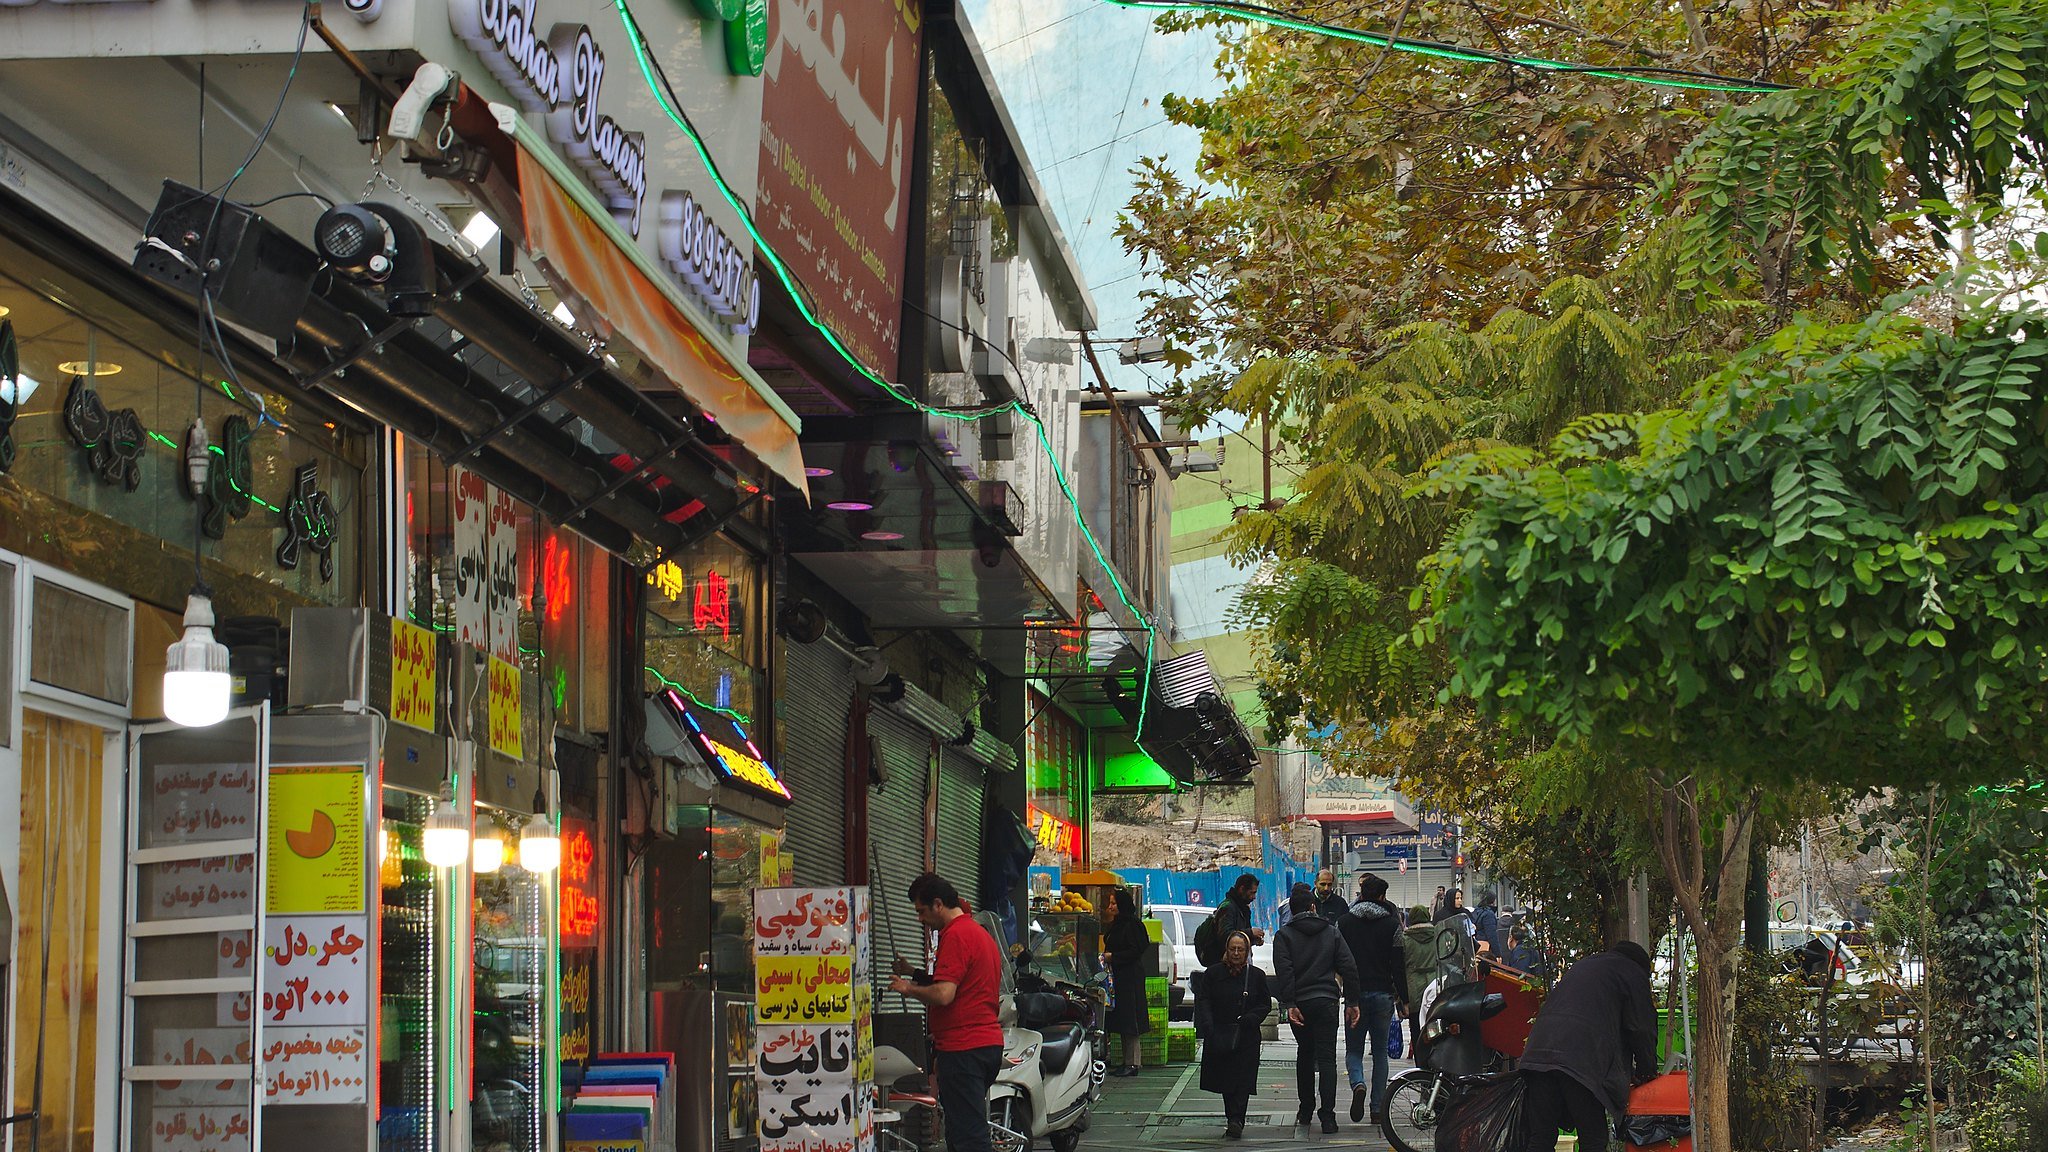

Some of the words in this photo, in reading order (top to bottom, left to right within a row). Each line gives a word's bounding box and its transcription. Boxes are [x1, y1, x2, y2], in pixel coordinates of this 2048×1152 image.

[574, 31, 645, 238] Narenj
[810, 174, 831, 219] Indoor
[682, 196, 759, 329] 88951790
[163, 809, 201, 833] تومان
[205, 808, 246, 829] ۱۵۰۰۰
[1373, 836, 1391, 849] دستی
[161, 885, 205, 908] تومان
[208, 883, 247, 903] ۵۰۰۰
[756, 890, 848, 940] فتوکپی
[275, 924, 308, 966] دل
[317, 925, 364, 966] جگر
[758, 939, 781, 955] سفید
[784, 945, 789, 955] و
[792, 939, 812, 955] سیاه
[821, 939, 847, 955] رنگی
[759, 968, 793, 994] سیمی
[805, 957, 851, 994] صحافی
[293, 976, 349, 1013] ۲۰۰۰
[803, 993, 850, 1019] کتابهای
[760, 998, 798, 1019] درسی
[262, 1032, 323, 1062] مخصوص
[326, 1034, 363, 1062] چنجه
[763, 1029, 815, 1053] طراحی
[760, 1027, 850, 1094] تایپ
[266, 1070, 312, 1096] تومان
[312, 1069, 363, 1091] ۱۱۰۰۰
[156, 1112, 187, 1142] قلوه
[193, 1113, 216, 1141] دل
[761, 1093, 851, 1139] اسکن
